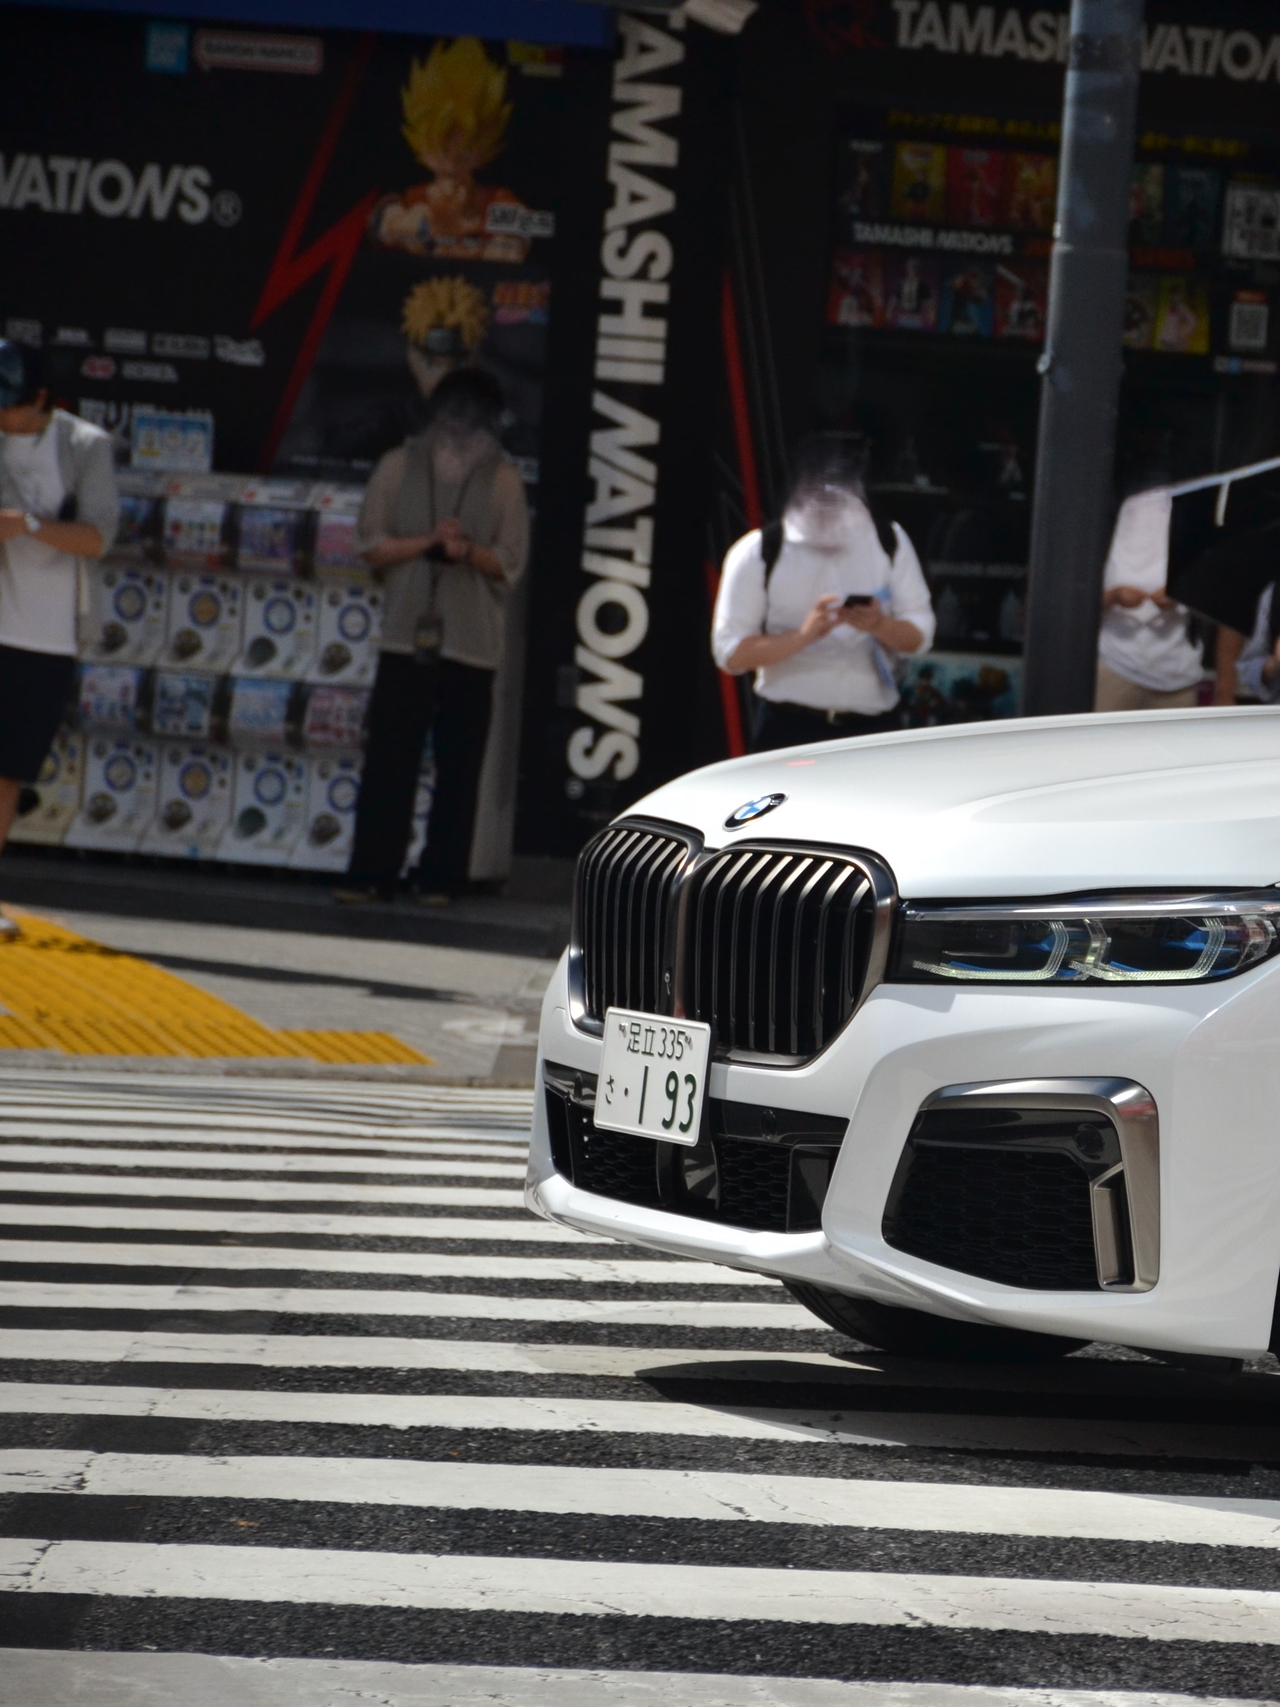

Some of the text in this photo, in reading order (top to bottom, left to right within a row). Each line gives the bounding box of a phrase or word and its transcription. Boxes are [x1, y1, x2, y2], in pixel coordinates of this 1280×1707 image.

[567, 388, 661, 781] NATIONS
[627, 1022, 686, 1060] 足立 335
[605, 1074, 615, 1105] さ
